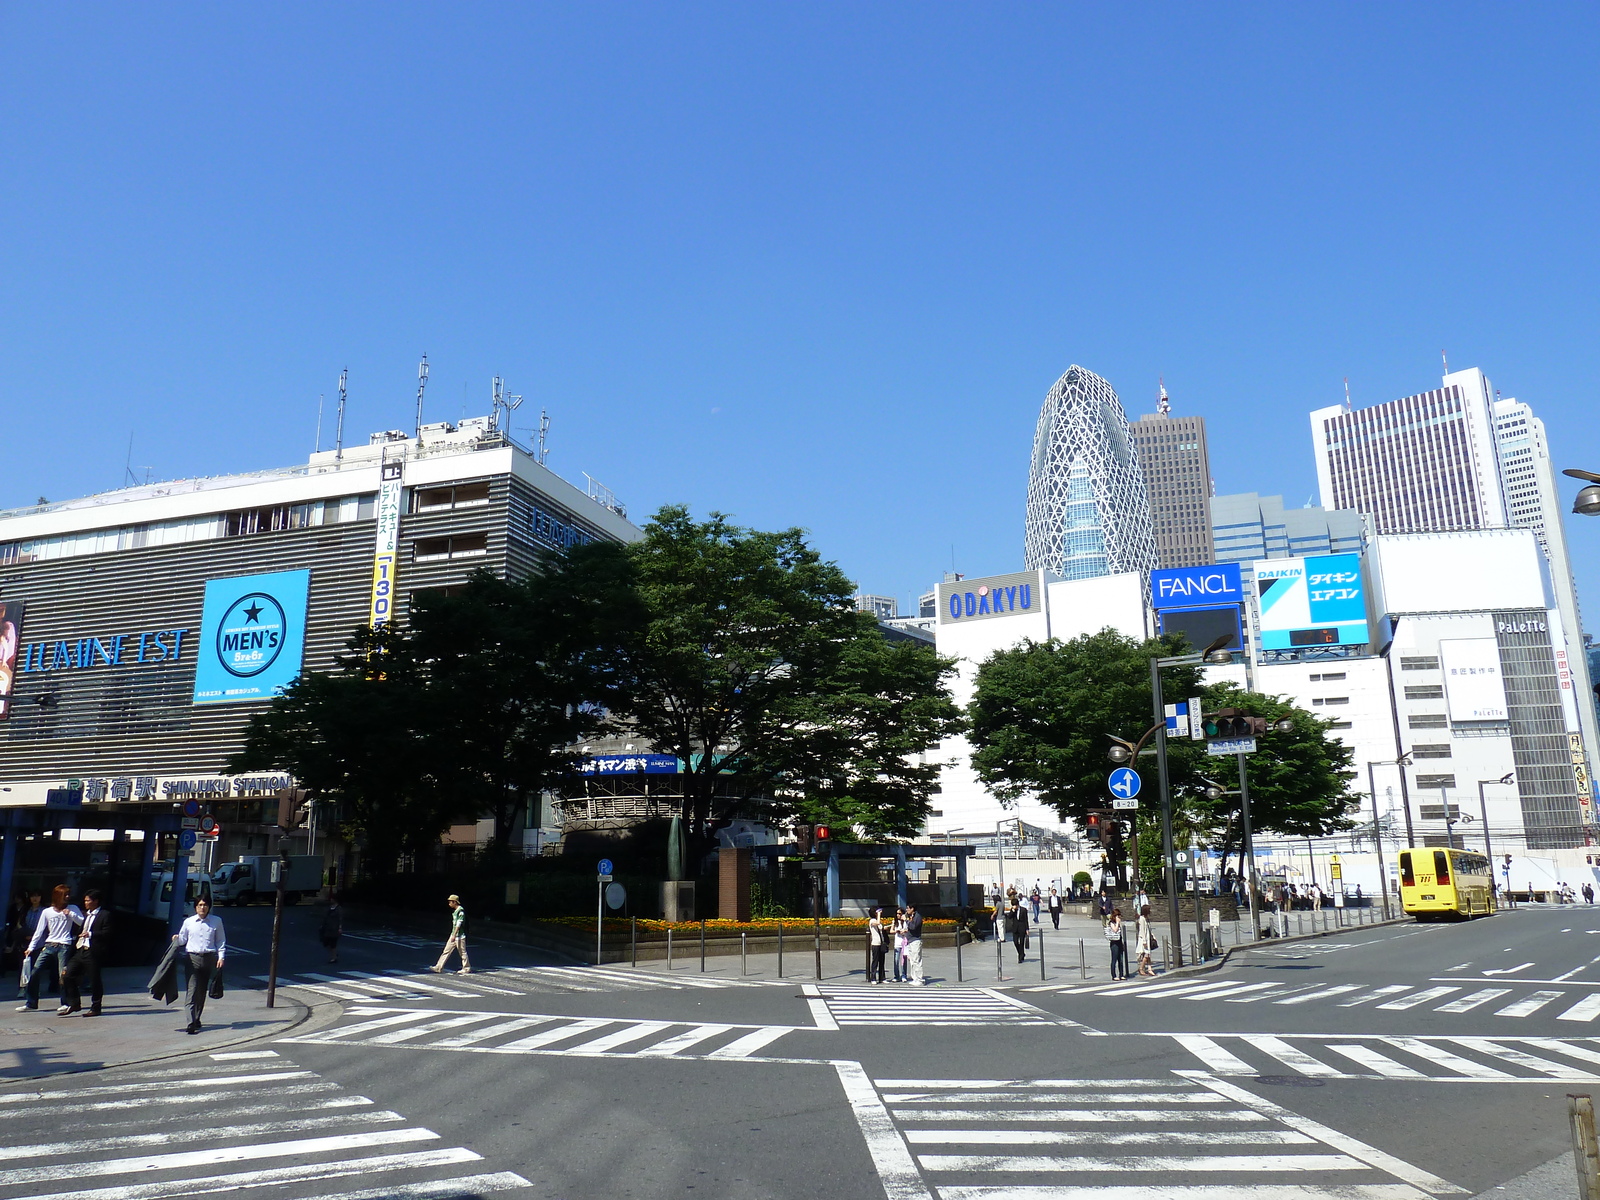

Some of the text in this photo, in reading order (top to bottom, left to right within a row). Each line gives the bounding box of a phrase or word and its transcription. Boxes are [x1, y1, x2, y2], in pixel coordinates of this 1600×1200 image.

[1159, 573, 1236, 598] FANCL
[1258, 568, 1302, 579] DAIKIN
[1308, 572, 1358, 586] ダイキン
[949, 583, 1031, 618] ODAKYU
[1311, 588, 1360, 602] エアコン
[24, 629, 188, 673] LUMINE EST
[85, 776, 156, 800] 新宿駅
[162, 778, 229, 795] SHINJUKU
[233, 775, 291, 791] STATION
